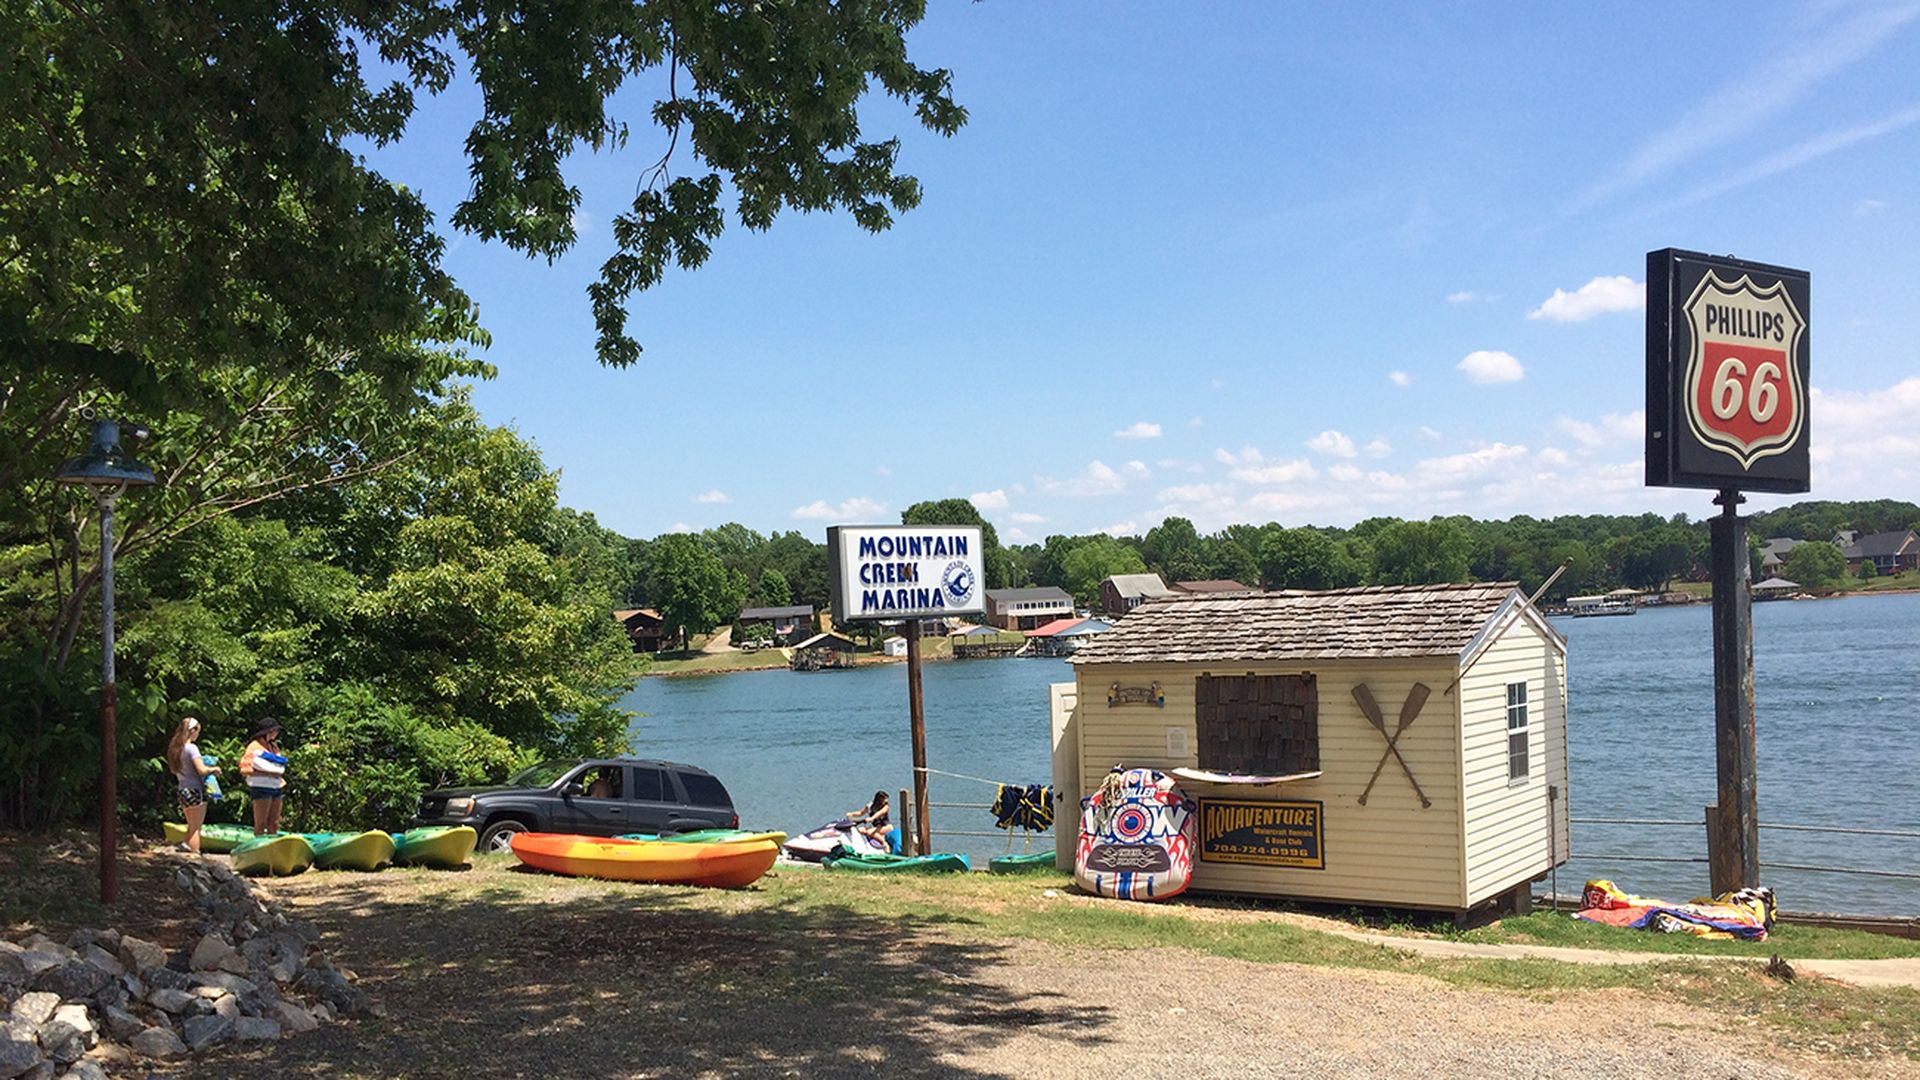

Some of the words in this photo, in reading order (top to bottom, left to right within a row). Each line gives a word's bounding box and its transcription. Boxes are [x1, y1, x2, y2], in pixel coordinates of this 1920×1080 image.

[1706, 303, 1785, 342] PHILLIPS
[1711, 357, 1782, 424] 66
[859, 535, 968, 557] MOUNTAIN
[859, 562, 919, 585] CREEK
[861, 588, 945, 610] MARINA
[1206, 805, 1314, 841] AQUAVENTURE
[1253, 827, 1287, 836] Watercraft
